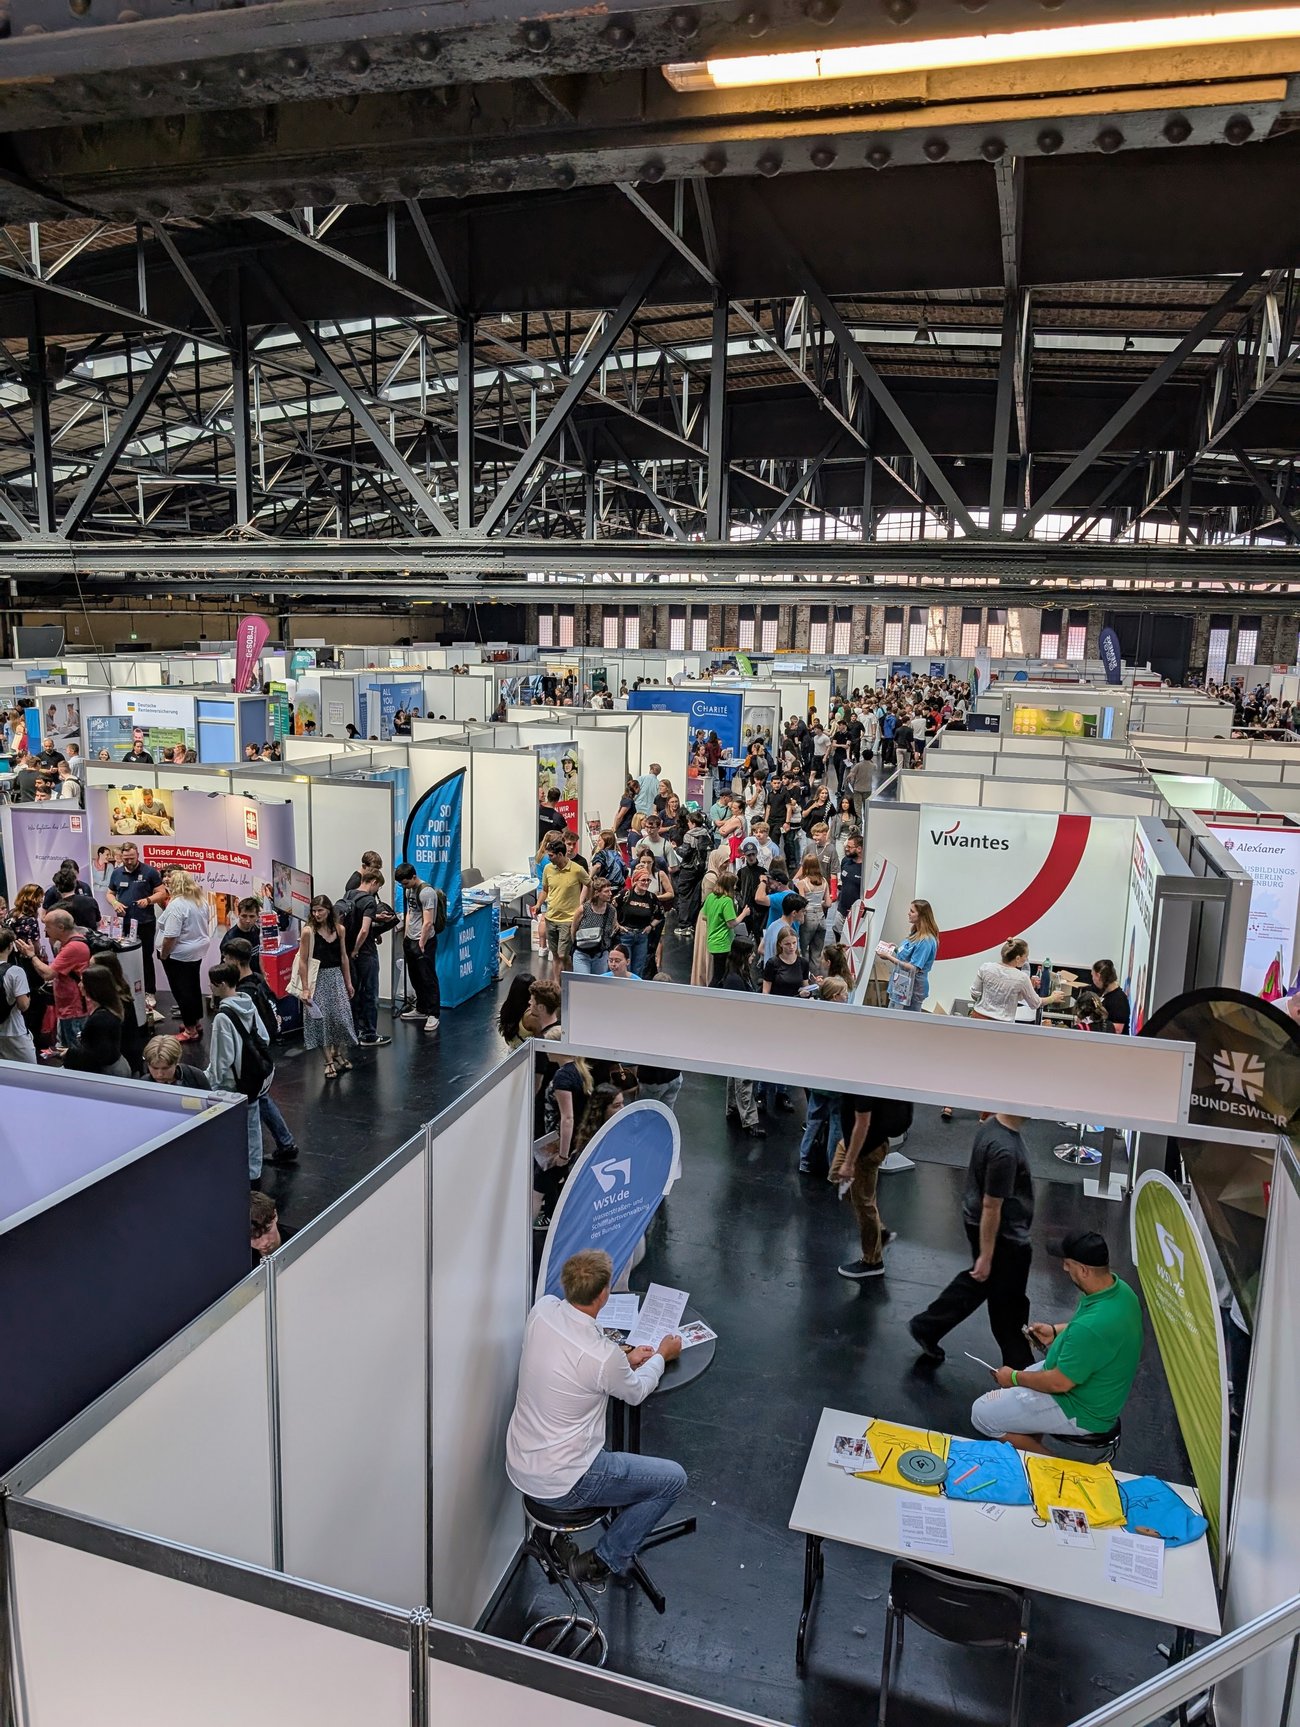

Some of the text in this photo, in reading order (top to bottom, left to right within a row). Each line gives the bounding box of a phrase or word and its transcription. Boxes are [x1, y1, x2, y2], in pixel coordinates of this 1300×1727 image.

[382, 688, 391, 696] ALL
[383, 697, 394, 705] YOU
[383, 705, 395, 714] NEED
[440, 804, 451, 818] SO
[428, 819, 451, 833] POOL
[416, 834, 451, 848] IST NUR
[930, 829, 1010, 851] Vivantes
[1236, 842, 1286, 855] Alexianer
[148, 847, 250, 868] Unser Auftrag ist das Leben,
[416, 849, 451, 863] BERLIN.
[1245, 865, 1298, 876] USBILDUNGS-
[1254, 872, 1283, 881] BERLIN
[1253, 880, 1284, 888] ENBURG
[459, 945, 471, 961] MAL
[1190, 1093, 1288, 1128] BUNDESWEHR
[593, 1189, 630, 1211] WSV.de
[633, 1196, 644, 1207] und
